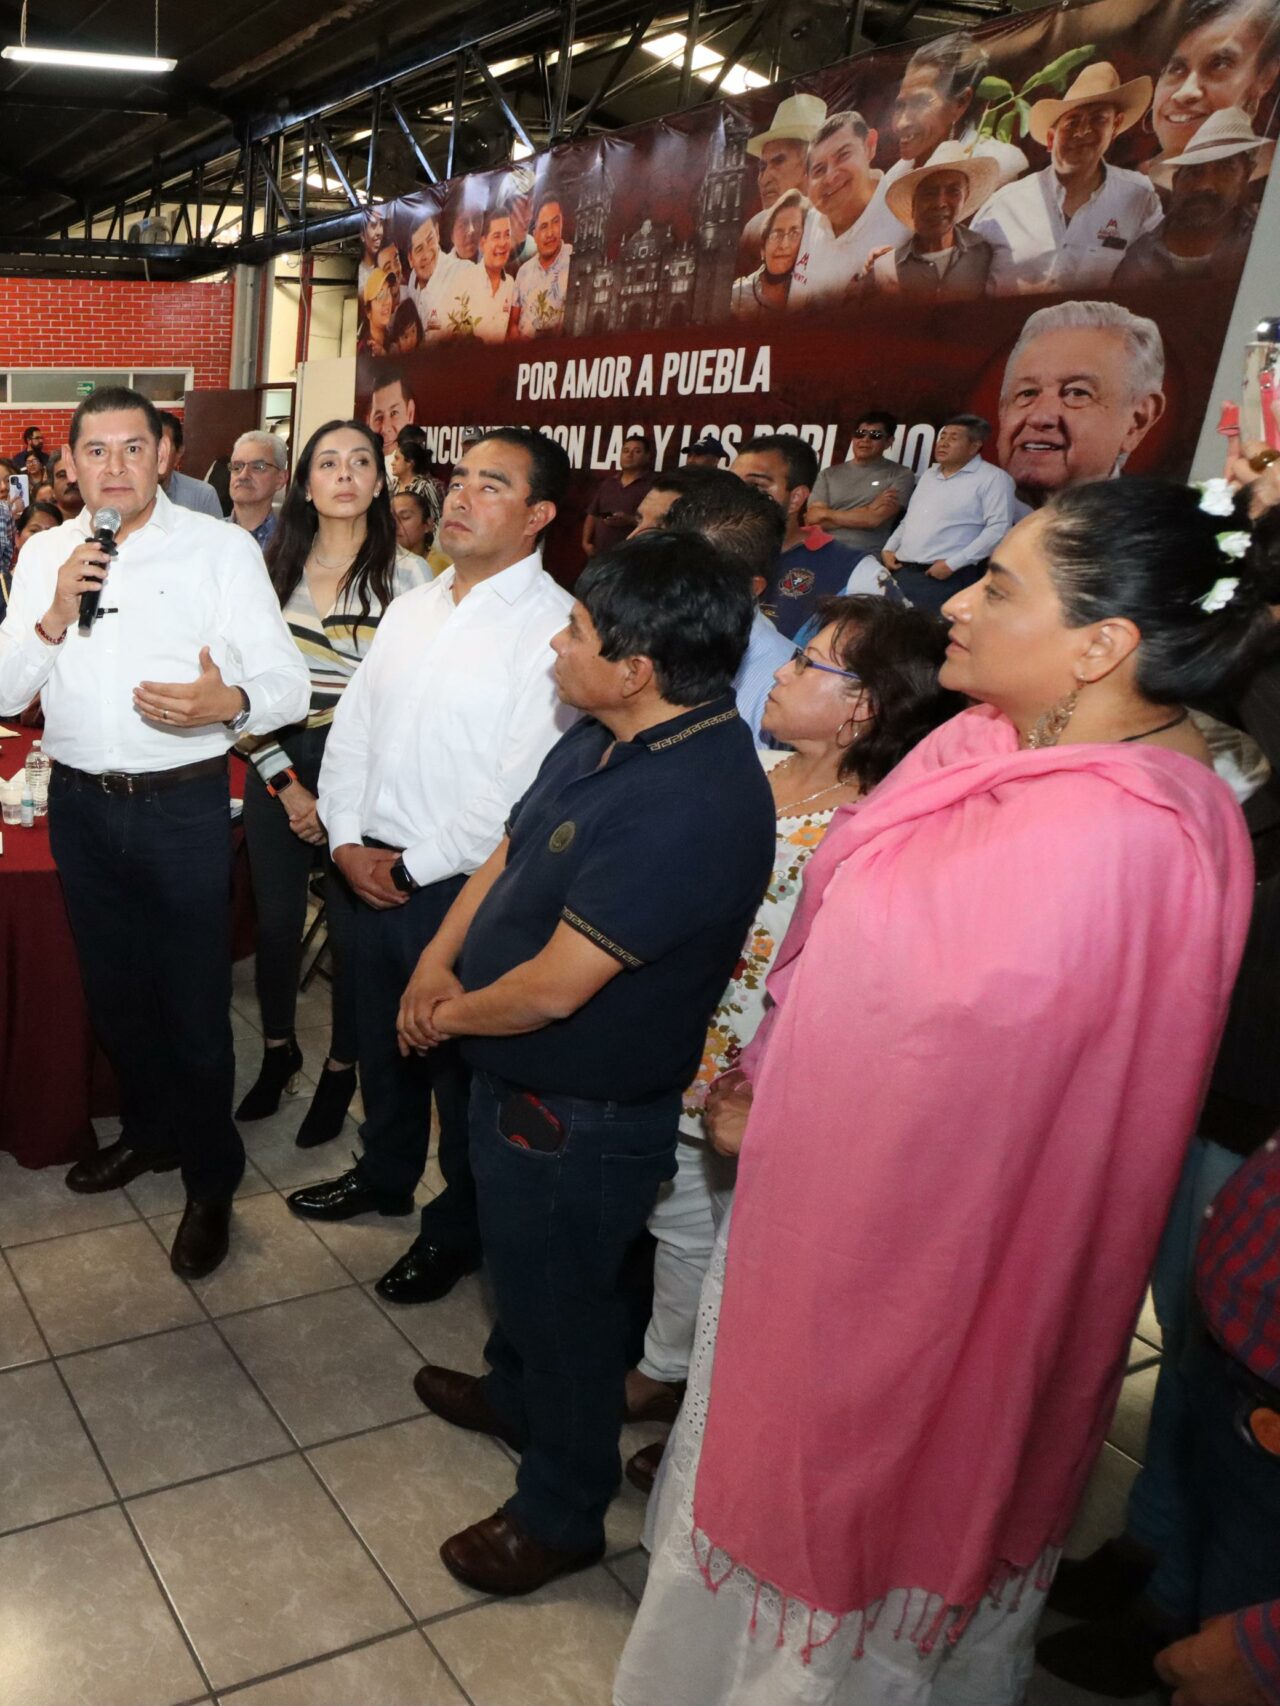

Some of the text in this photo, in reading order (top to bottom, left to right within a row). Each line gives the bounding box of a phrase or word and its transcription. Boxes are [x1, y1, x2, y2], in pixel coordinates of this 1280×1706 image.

[516, 345, 771, 400] POR AMOR A PUEBLA
[590, 424, 645, 471] LA
[653, 425, 675, 472] Y
